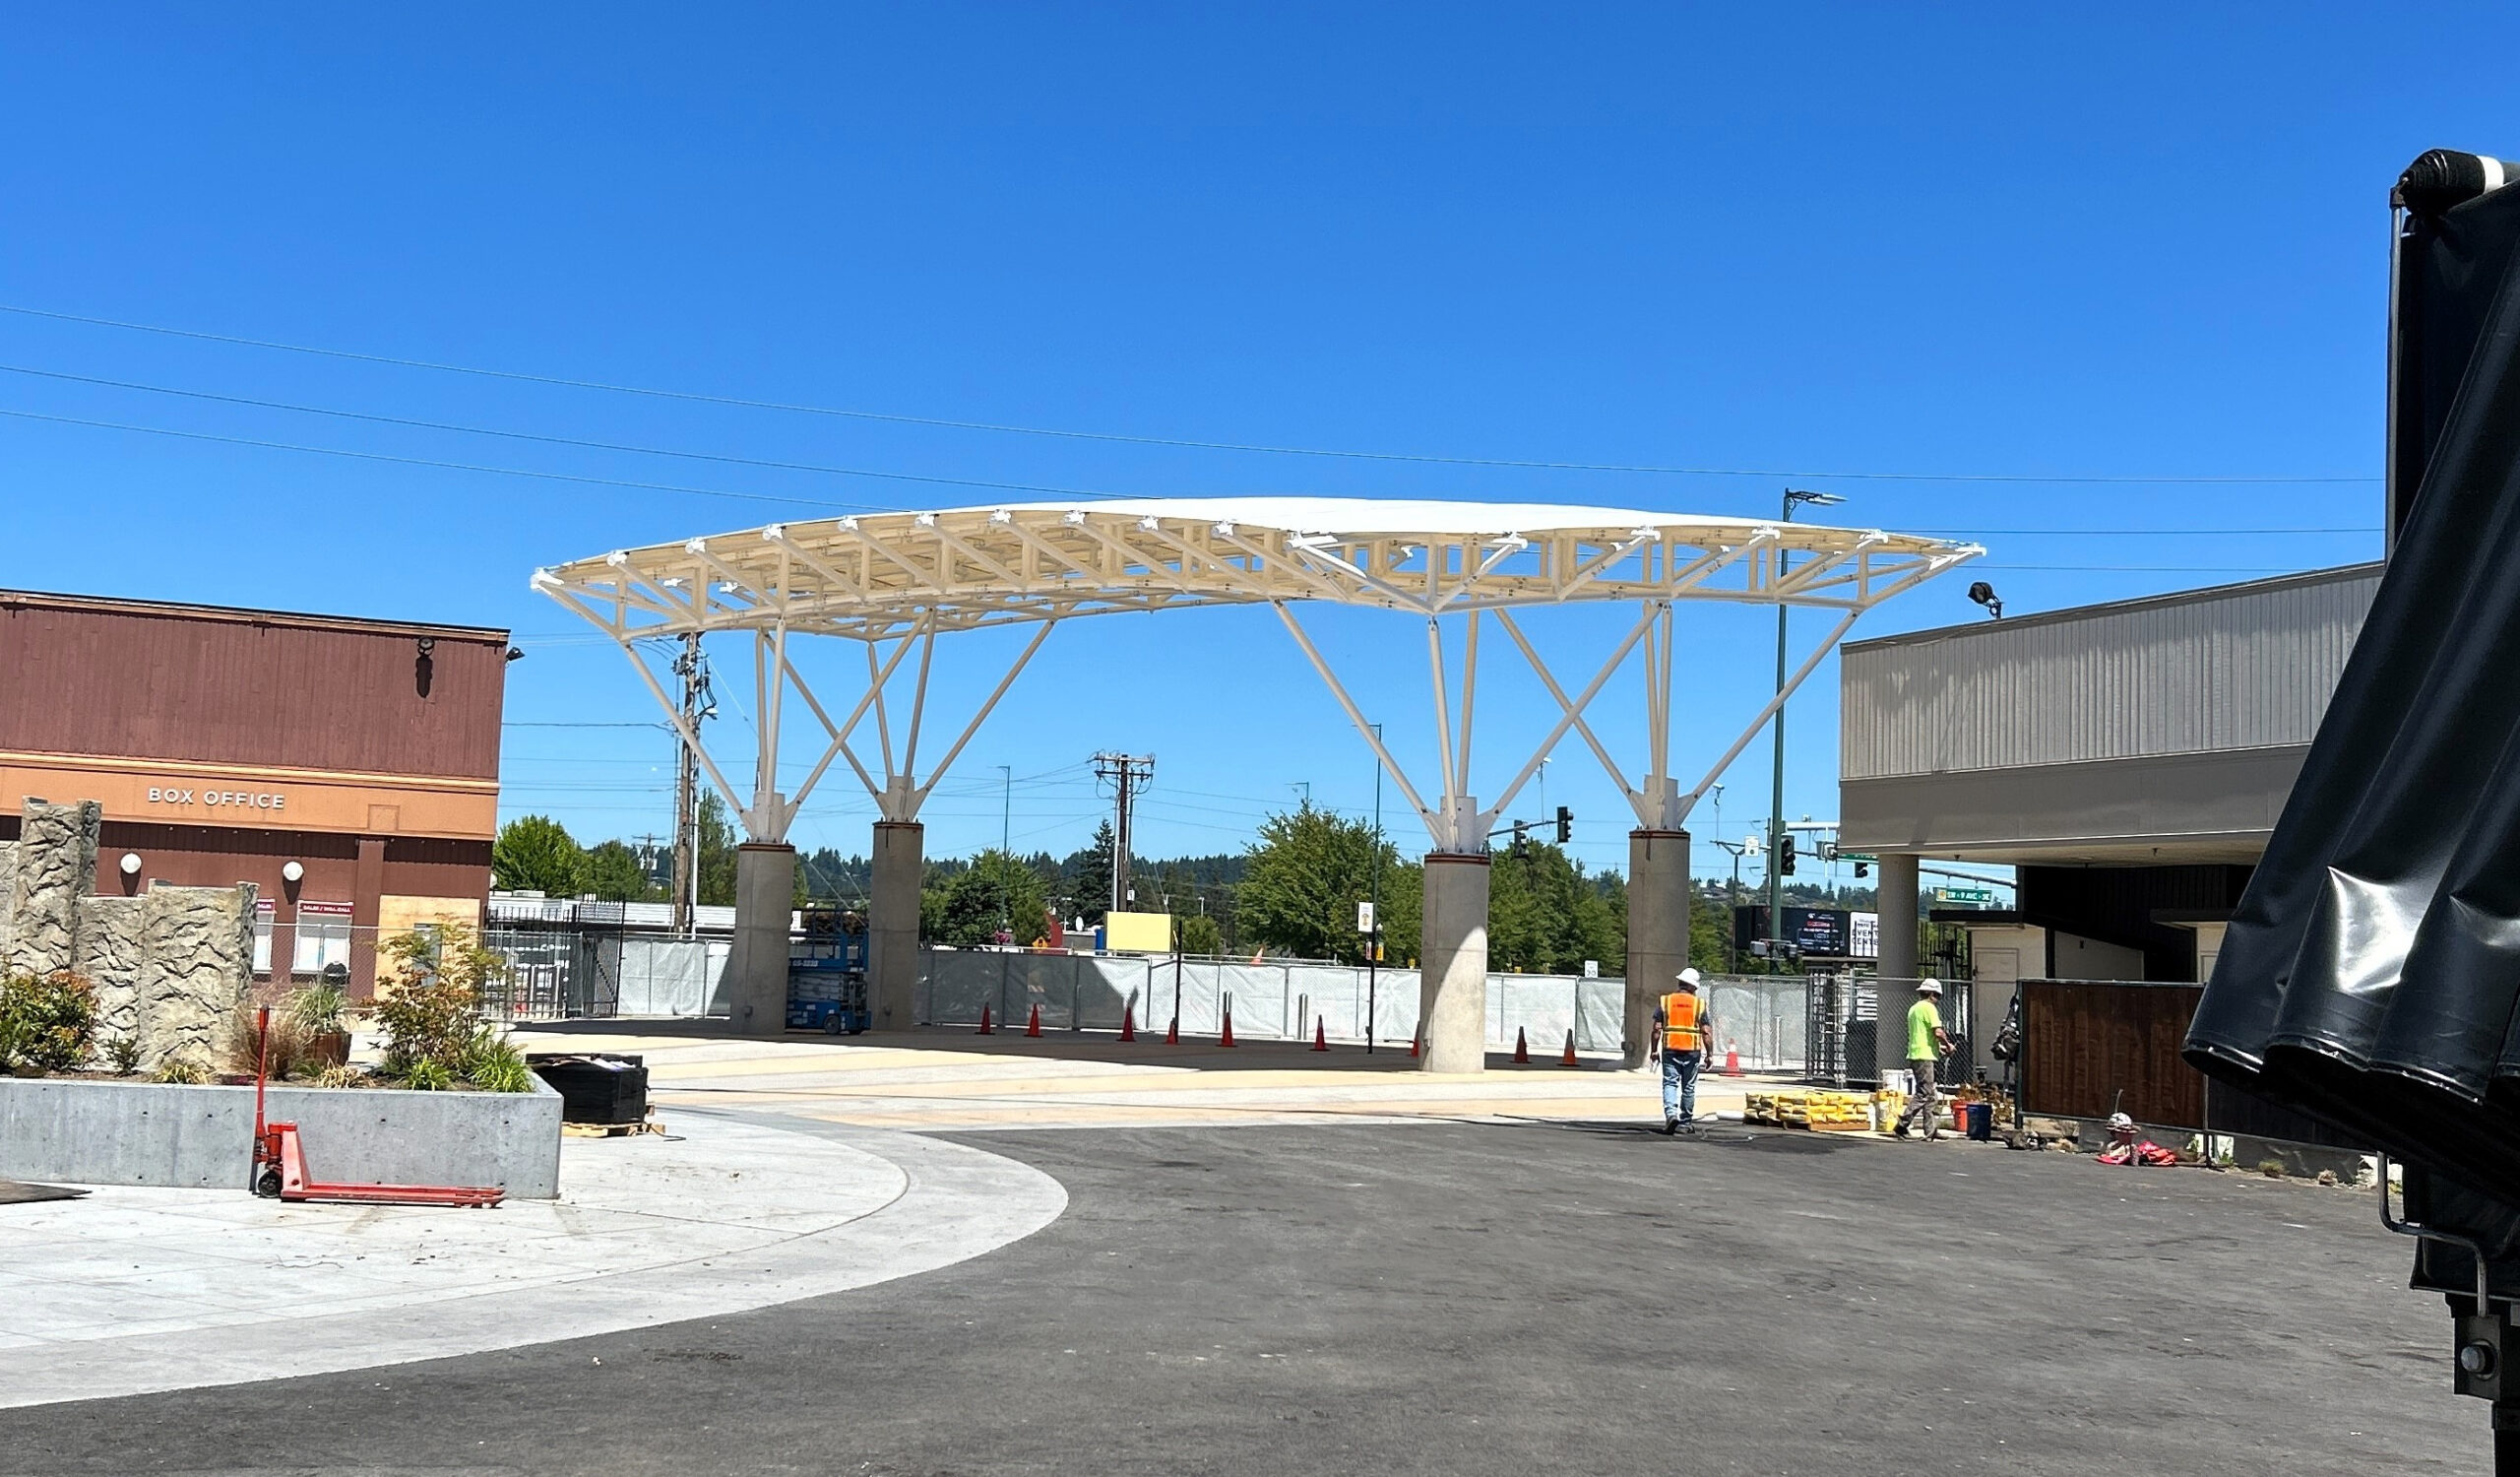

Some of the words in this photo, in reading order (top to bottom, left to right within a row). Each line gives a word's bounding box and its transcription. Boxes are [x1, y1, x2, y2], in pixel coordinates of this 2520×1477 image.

[149, 788, 194, 805] BOX
[204, 791, 285, 809] OFFICE
[1852, 937, 1879, 946] CENTE
